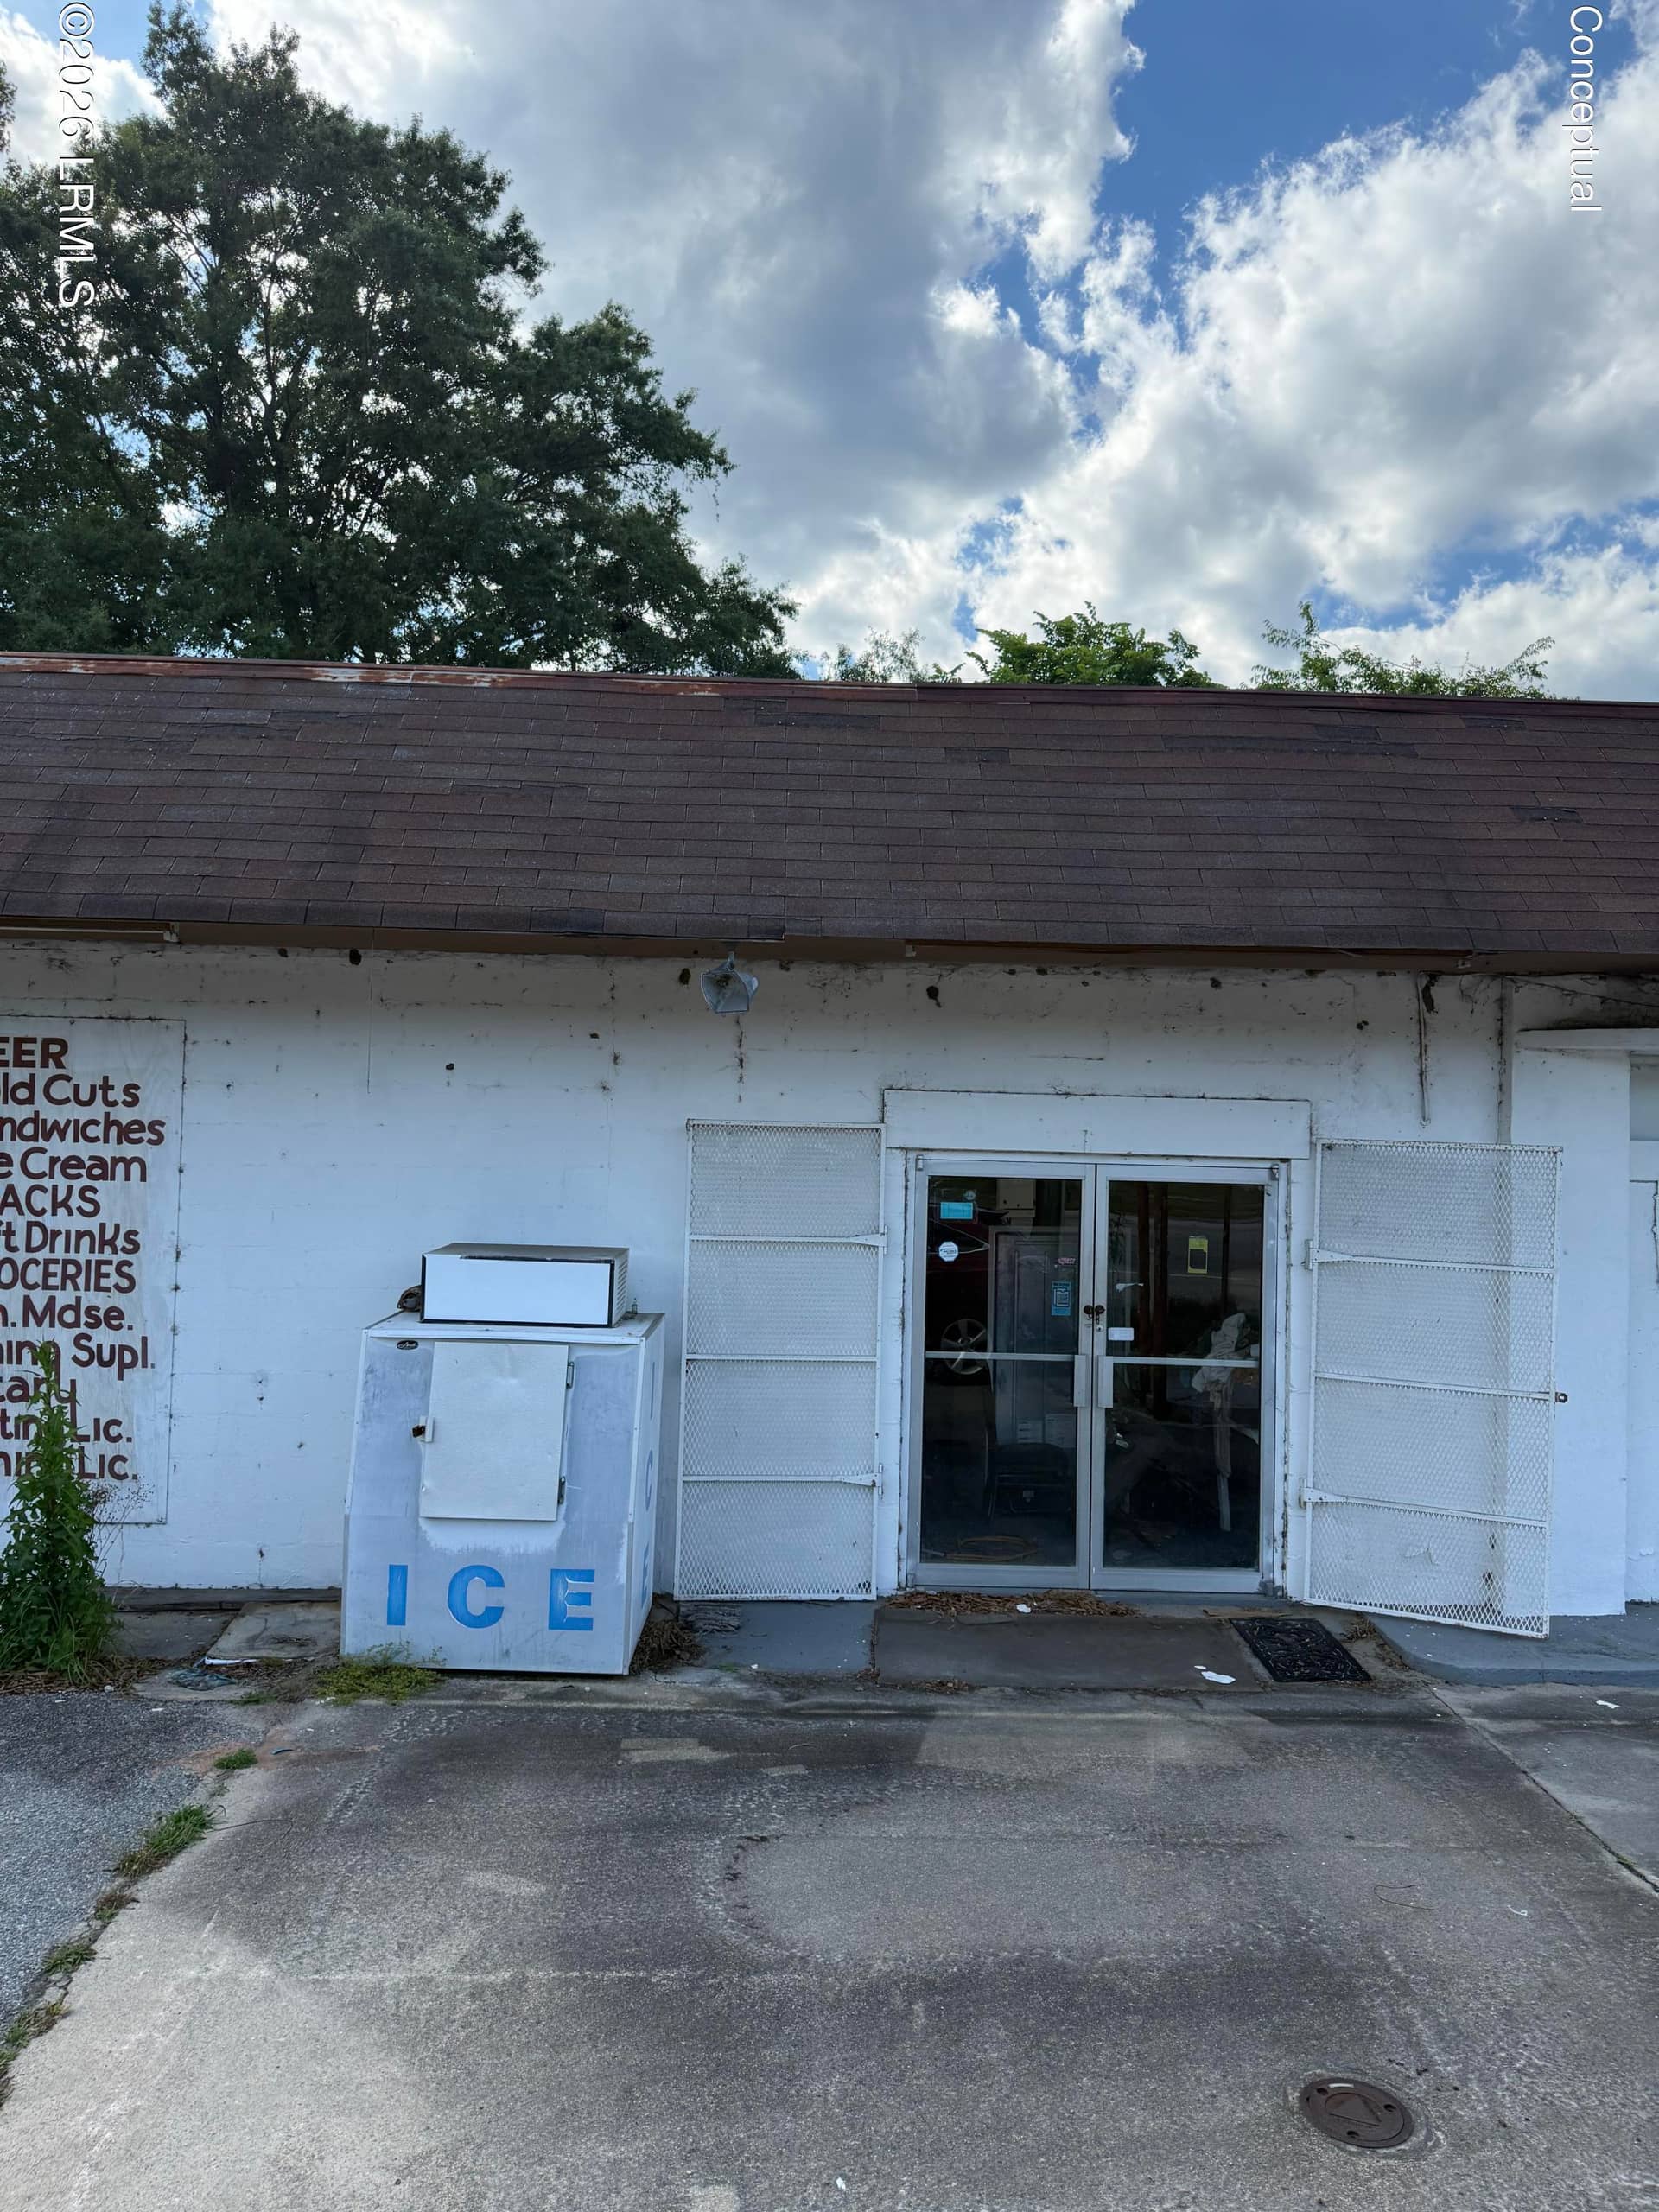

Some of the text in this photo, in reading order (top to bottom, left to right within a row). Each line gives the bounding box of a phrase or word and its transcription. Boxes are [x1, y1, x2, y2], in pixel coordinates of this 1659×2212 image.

[43, 1074, 141, 1108] Cuts
[20, 1147, 147, 1182] Cream
[0, 1184, 100, 1217] ACKS
[0, 1257, 136, 1294] OCERIES
[22, 1294, 133, 1331] Mdse.
[72, 1332, 156, 1381] Supl.
[71, 1412, 132, 1442] Lic.
[78, 1446, 137, 1480] Lic.
[386, 1565, 595, 1631] ICE
